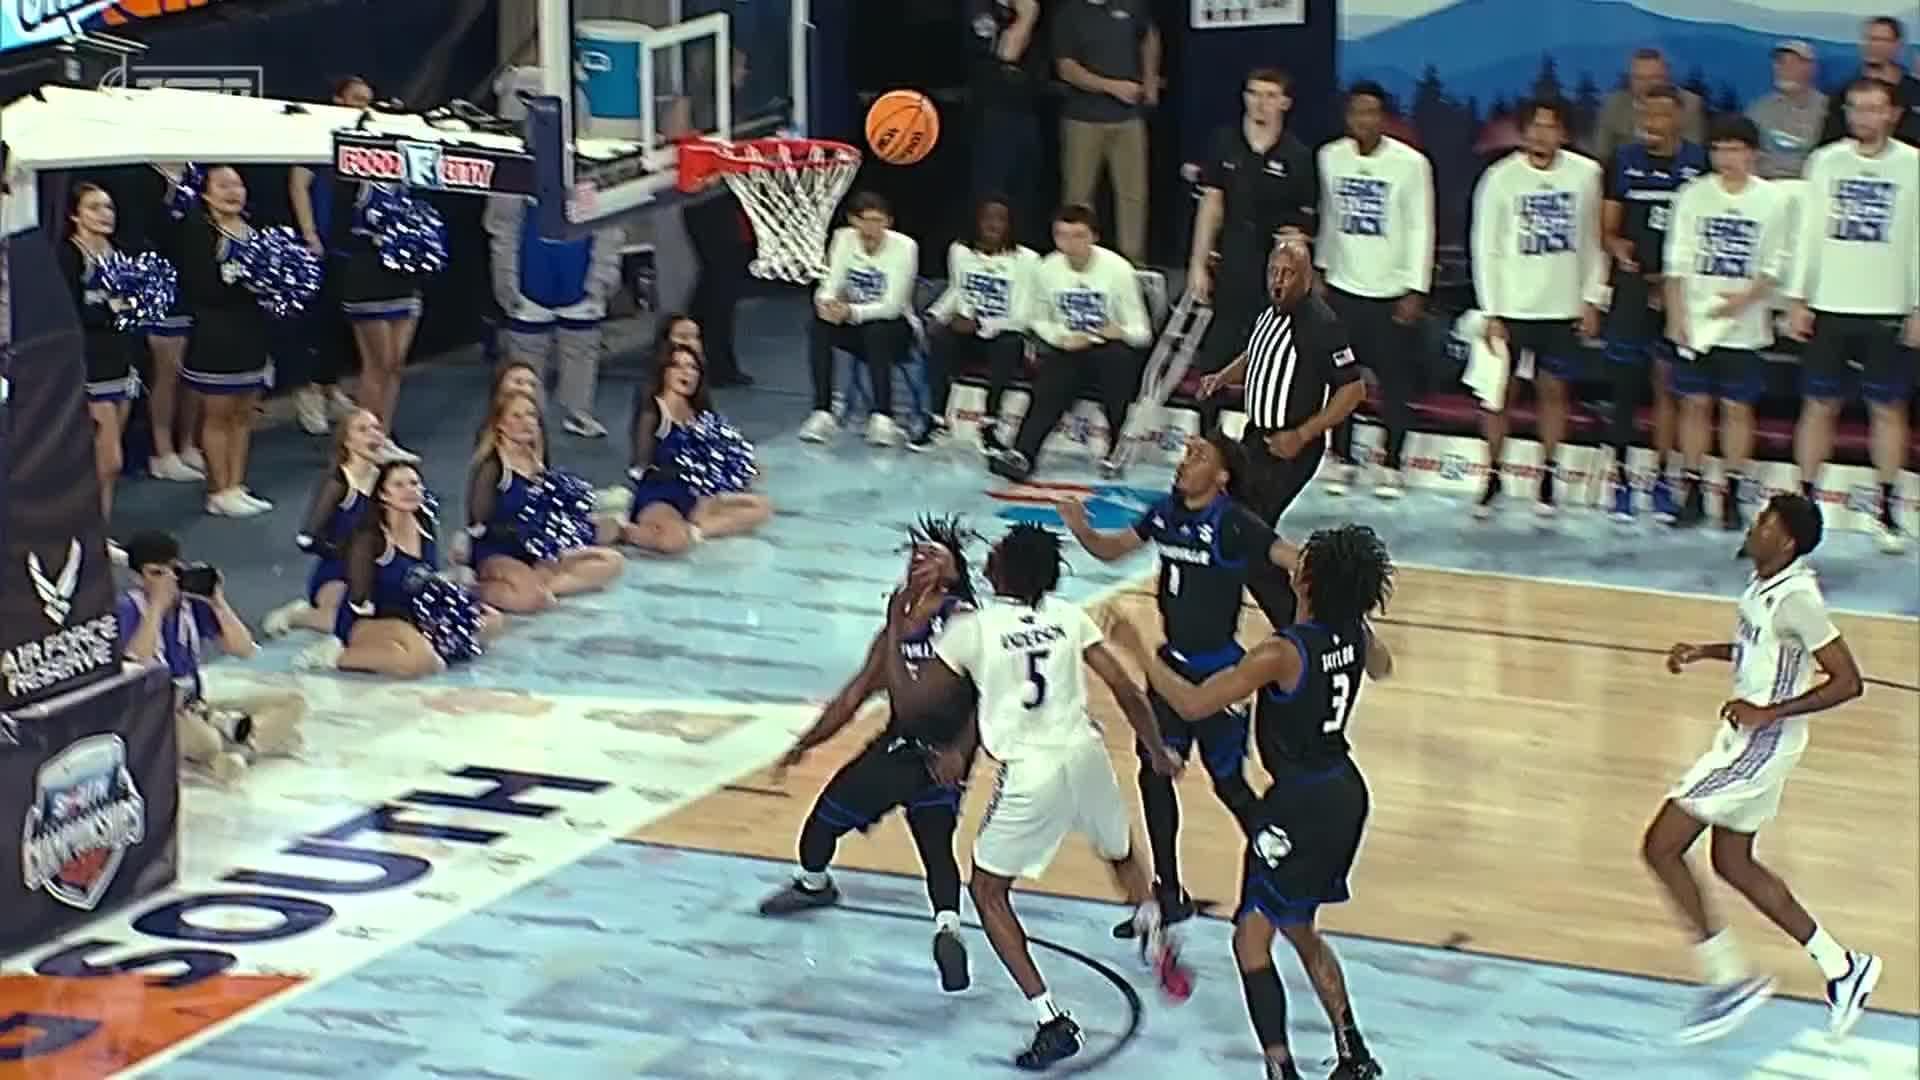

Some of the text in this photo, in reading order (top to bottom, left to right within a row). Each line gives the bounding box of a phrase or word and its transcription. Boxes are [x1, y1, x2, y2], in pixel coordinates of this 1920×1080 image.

[338, 144, 403, 179] FOOD
[440, 155, 495, 189] CITY
[1021, 649, 1051, 711] 5
[1322, 673, 1350, 734] 3
[32, 763, 613, 990] SOUTH
